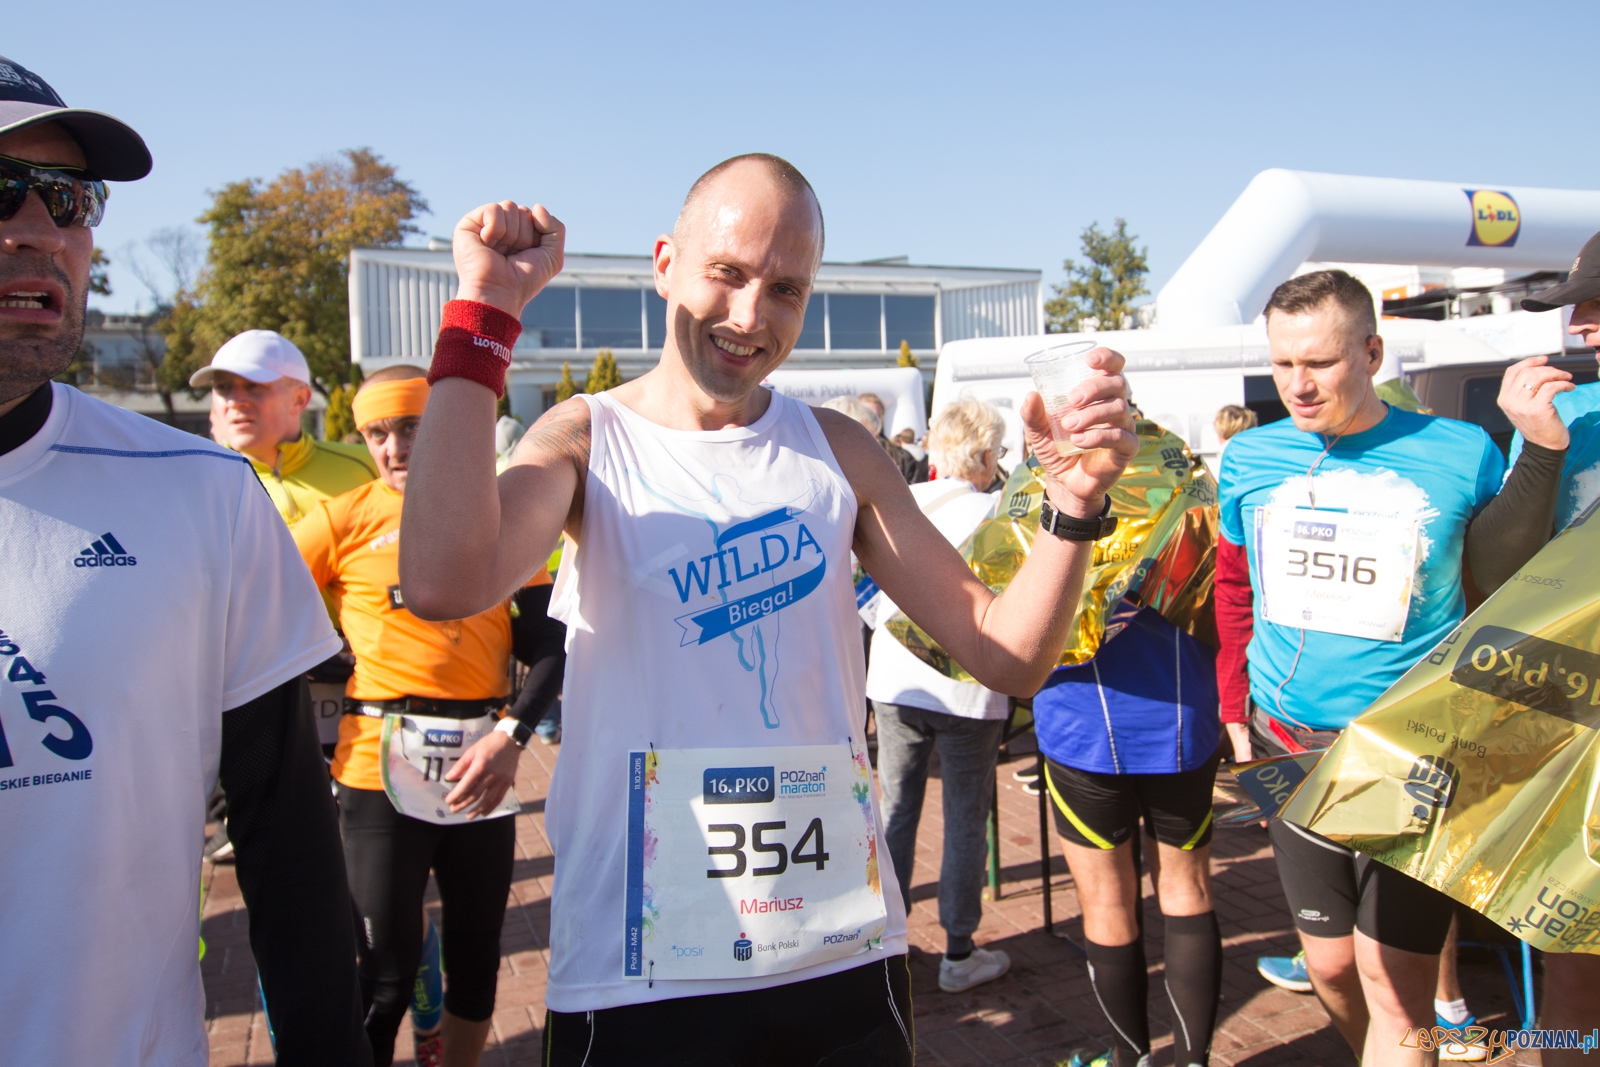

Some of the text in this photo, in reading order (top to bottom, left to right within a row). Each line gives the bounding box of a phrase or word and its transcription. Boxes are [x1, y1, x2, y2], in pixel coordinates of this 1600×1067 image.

[472, 335, 511, 363] Wilson
[784, 384, 857, 398] Bank Polski
[1311, 526, 1334, 537] PKO
[73, 553, 137, 568] adidas
[668, 523, 823, 604] WILDA
[1286, 548, 1377, 586] 3516
[1521, 573, 1566, 590] Sponsor
[728, 581, 794, 625] Biega!
[1471, 644, 1550, 689] PKO
[427, 733, 439, 743] 16.
[440, 734, 460, 744] PKO
[1406, 719, 1487, 758] Bank Polski
[32, 769, 92, 786] BIEGANIE
[634, 757, 642, 790] 11.10.2015
[709, 777, 770, 794] 16. PKO
[780, 781, 826, 795] maraton
[706, 817, 830, 879] 354
[1346, 836, 1399, 869] tytularny
[740, 897, 804, 915] Mariusz
[630, 927, 638, 946] M42
[757, 939, 800, 952] Bank Polski
[630, 952, 638, 970] Pohl
